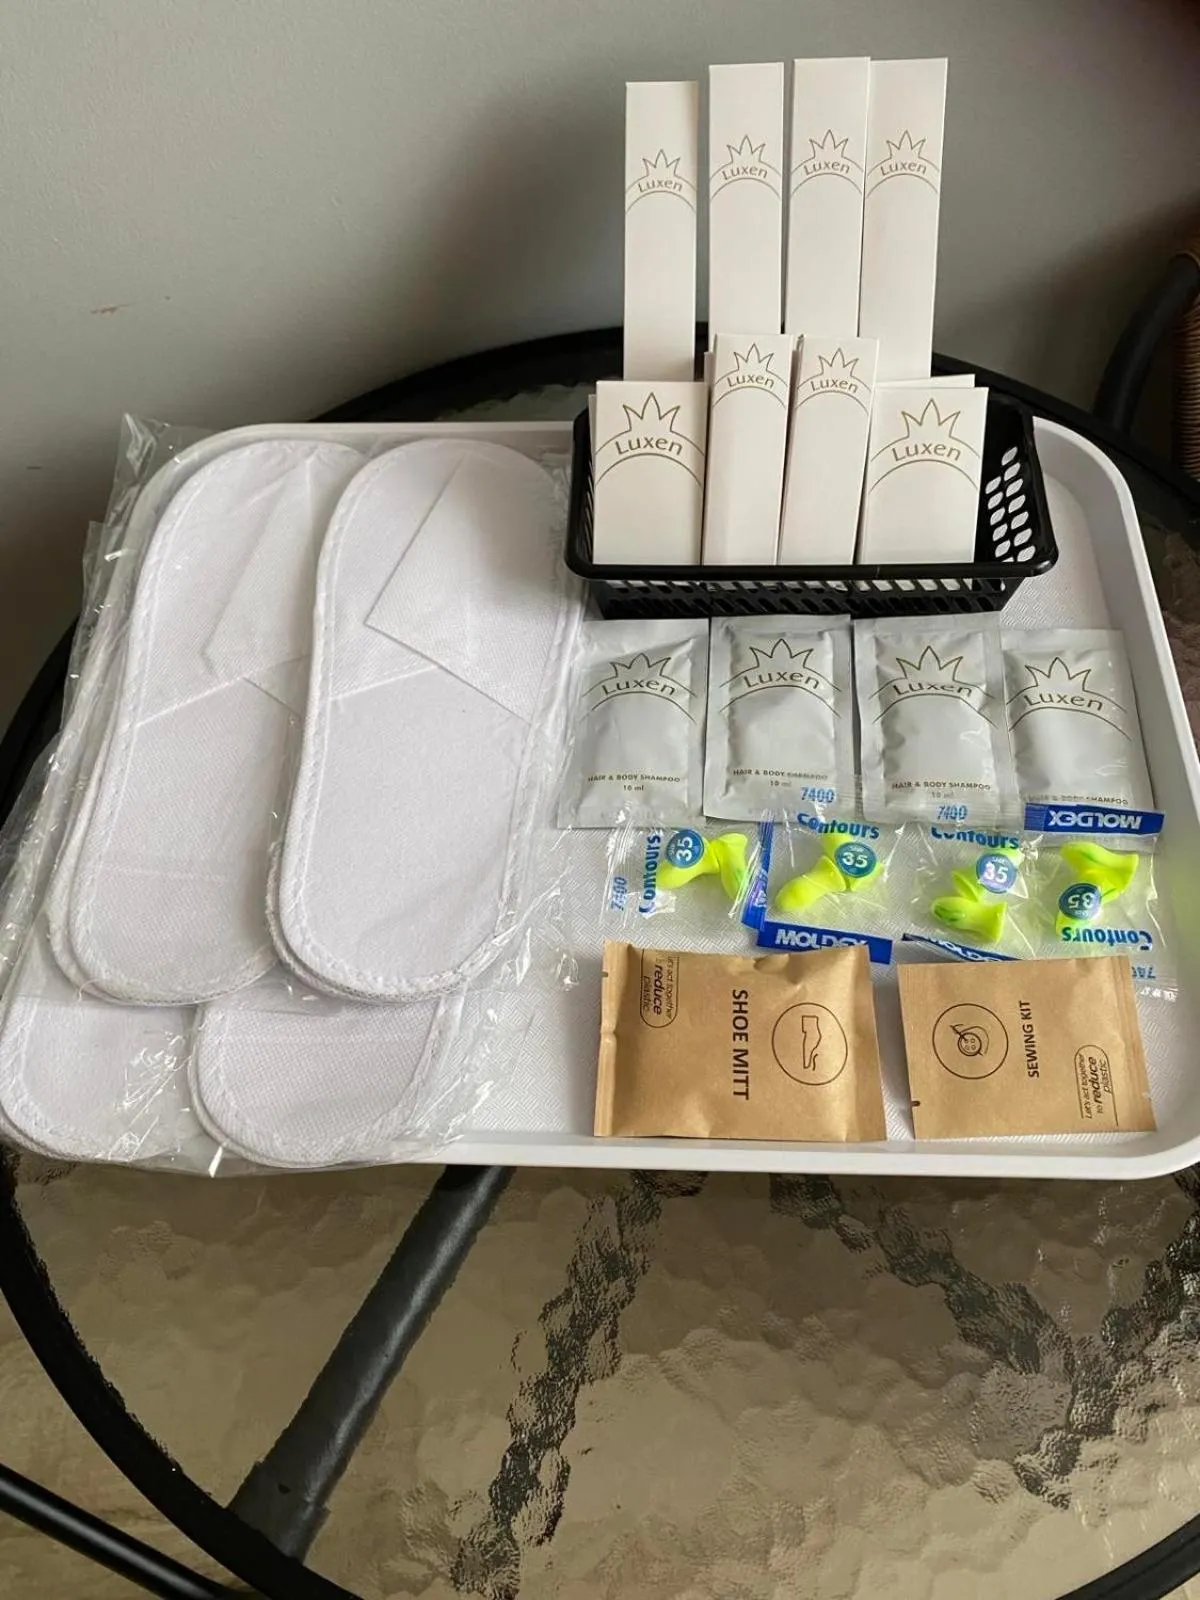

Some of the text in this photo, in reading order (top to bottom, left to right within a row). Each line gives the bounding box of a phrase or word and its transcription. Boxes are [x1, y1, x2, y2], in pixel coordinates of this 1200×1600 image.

[721, 162, 768, 181] Luxen
[804, 157, 851, 176] Luxen
[880, 160, 927, 177] Luxen
[637, 177, 683, 194] Luxen
[726, 373, 775, 389] Luxen
[810, 378, 859, 394] Luxen
[614, 435, 684, 456] Luxen
[891, 440, 962, 462] Luxen
[601, 678, 677, 696] Luxen
[743, 671, 822, 690] Luxen
[893, 682, 973, 697] Luxen
[1023, 692, 1104, 711] Luxen
[588, 774, 606, 783] HAIR
[640, 774, 681, 783] SHAMPOO
[892, 781, 912, 790] HAIR
[923, 781, 947, 789] BODY
[948, 781, 991, 791] SHAMPOO
[800, 787, 836, 803] 7400
[797, 812, 880, 840] Contours
[1048, 809, 1143, 831] MOLDEX
[675, 836, 693, 862] 35
[841, 851, 869, 868] 35
[982, 860, 1009, 884] 35
[1067, 893, 1095, 909] 35
[1061, 926, 1153, 951] Contours
[642, 976, 651, 1013] plastic
[653, 964, 665, 1015] reduce
[732, 989, 750, 1101] SHOE MITT
[1018, 1000, 1040, 1079] SEWING KIT
[1087, 1056, 1103, 1105] reduce
[1098, 1059, 1112, 1094] plastic
